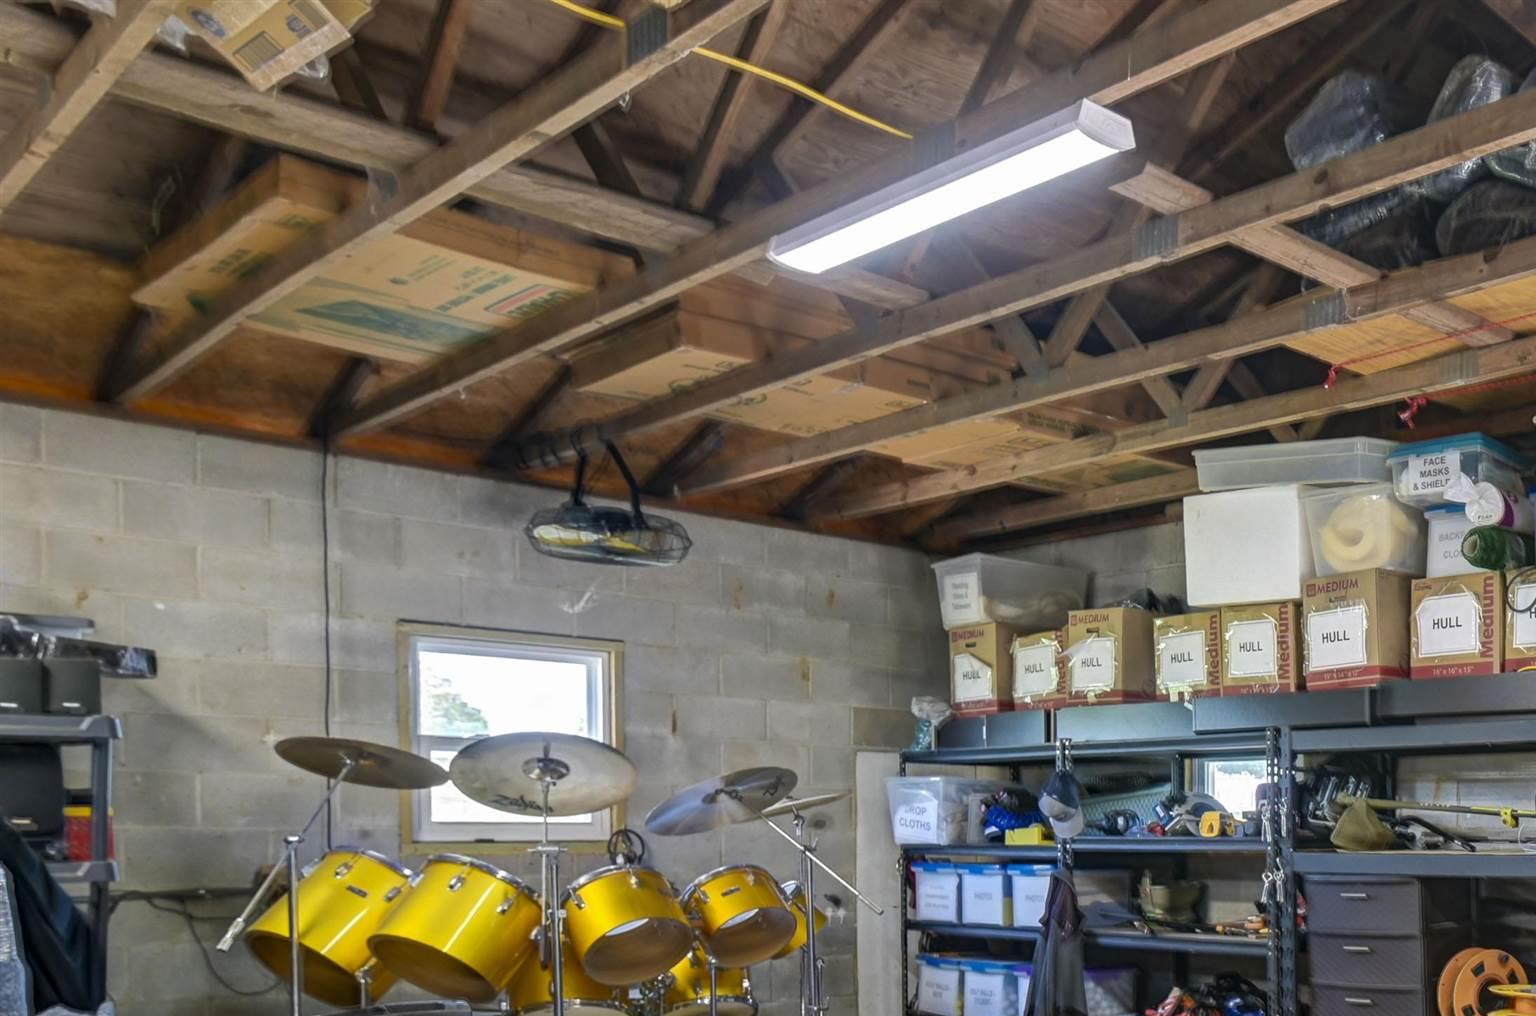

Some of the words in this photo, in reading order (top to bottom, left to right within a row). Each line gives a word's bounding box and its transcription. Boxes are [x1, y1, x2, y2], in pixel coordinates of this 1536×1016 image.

[1423, 456, 1447, 467] FACE
[1419, 467, 1450, 478] MASKS
[1413, 482, 1420, 491] &
[1316, 578, 1360, 596] MEDIUM
[1432, 616, 1463, 630] HULL
[1480, 575, 1495, 660] Medium
[1276, 602, 1289, 680] Medium
[1321, 630, 1350, 644] HULL
[1207, 614, 1218, 686] Medium
[1239, 641, 1263, 653] HULL
[1081, 657, 1102, 668] HULL
[1170, 652, 1194, 664] HULL
[962, 670, 982, 680] HULL
[1024, 664, 1045, 674] HULL
[899, 817, 932, 831] CLOTHS
